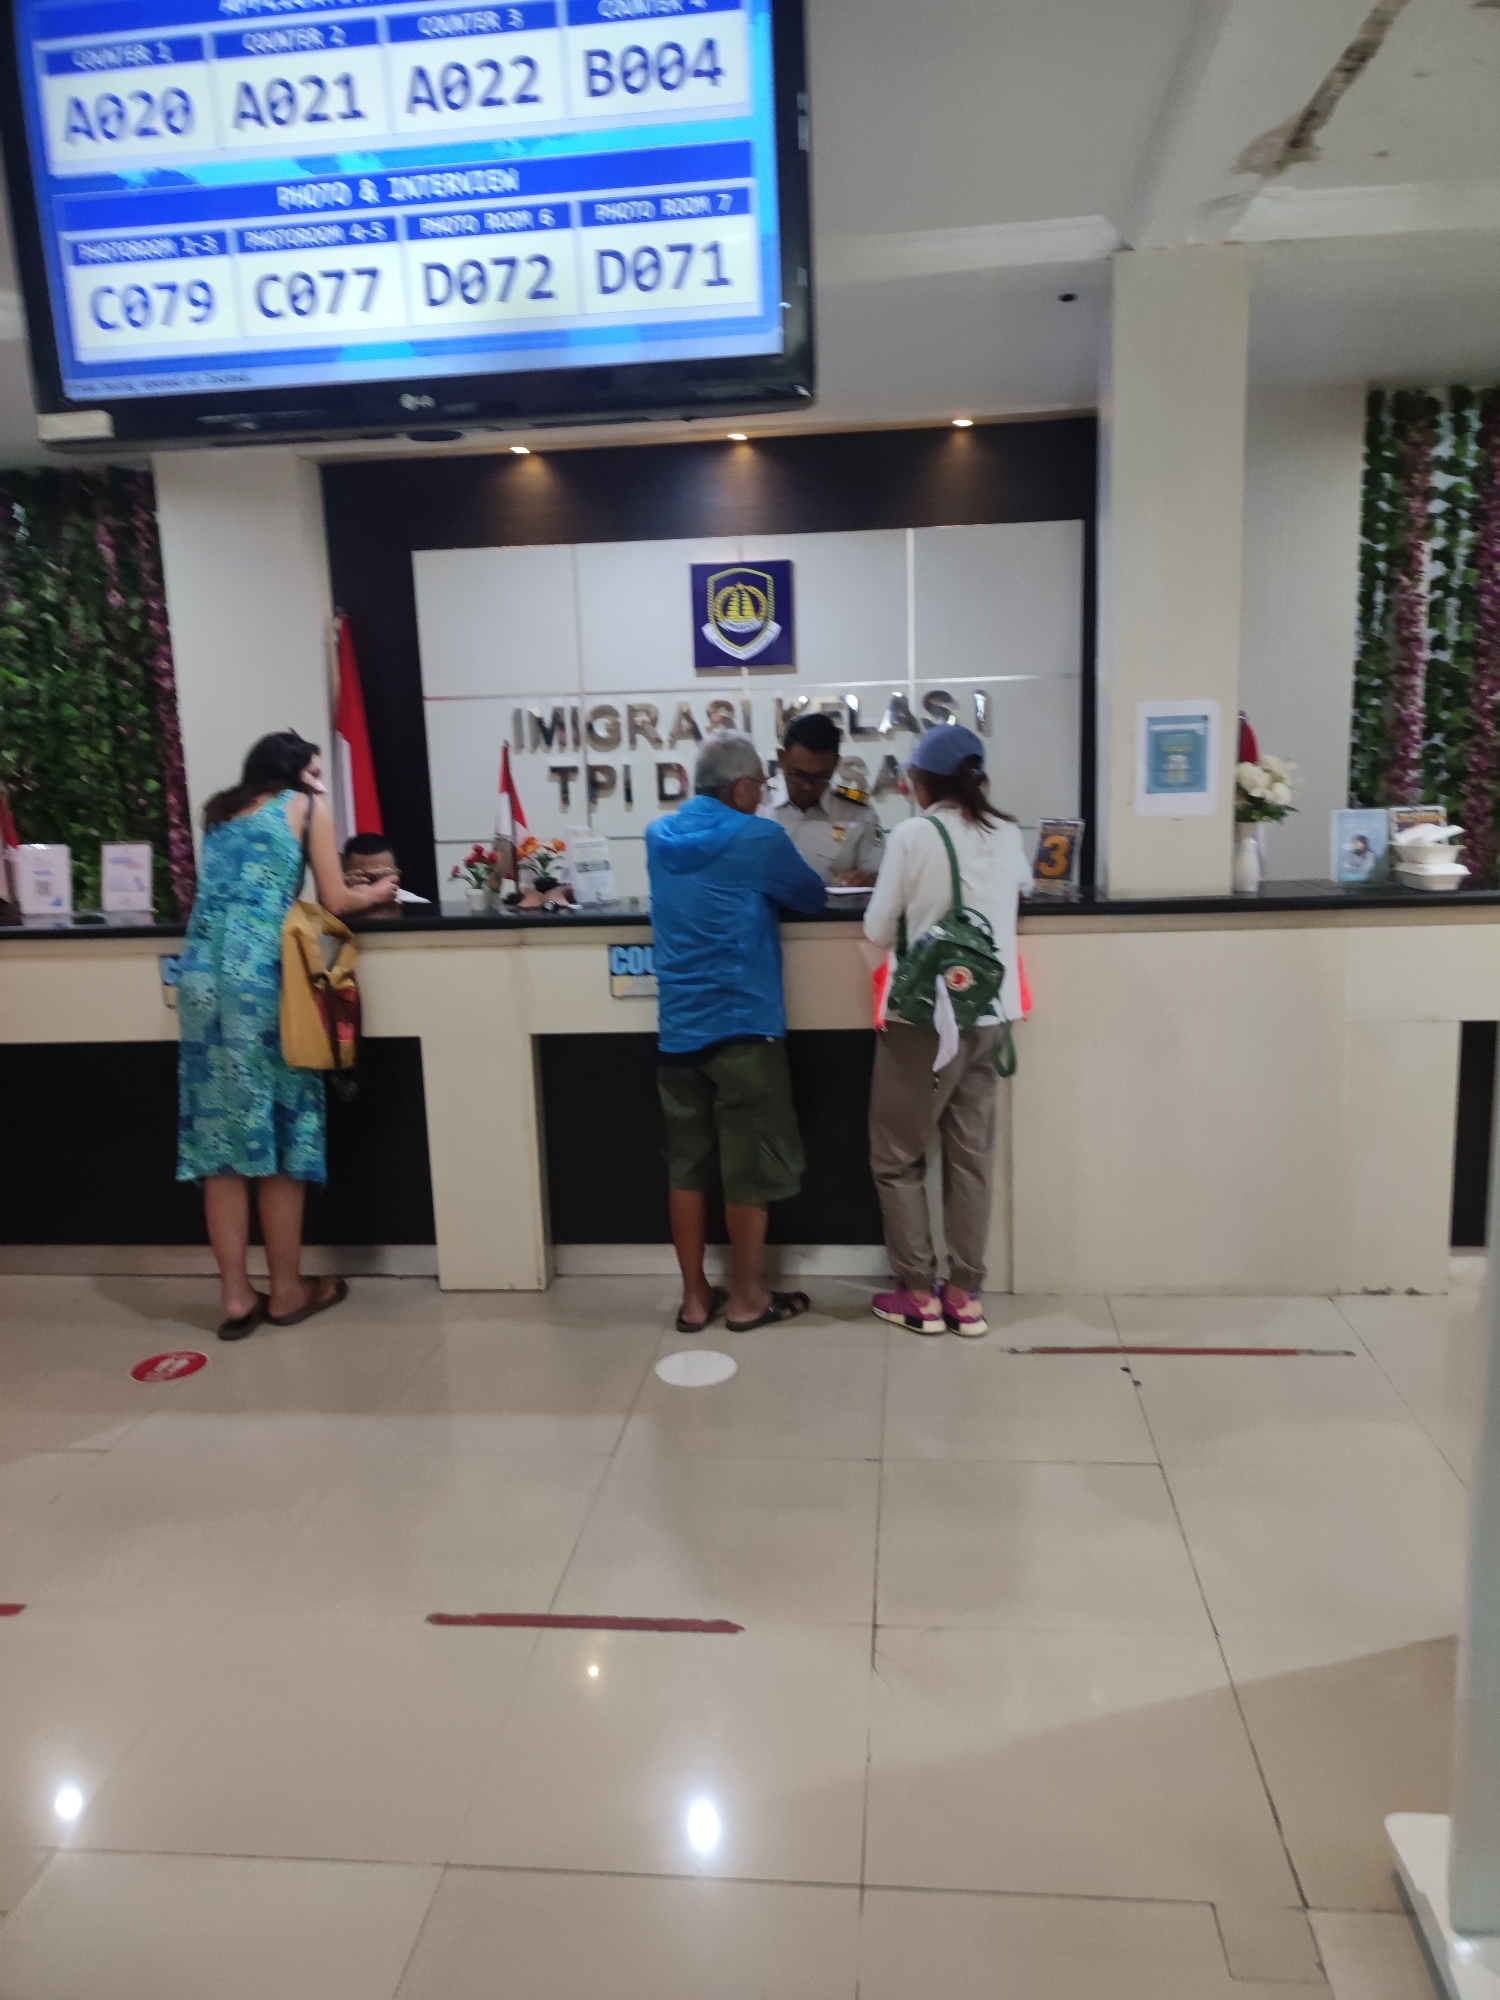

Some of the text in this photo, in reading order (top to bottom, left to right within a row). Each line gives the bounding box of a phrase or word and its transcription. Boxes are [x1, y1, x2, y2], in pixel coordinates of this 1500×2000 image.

[242, 25, 348, 55] COUNTER 2
[417, 8, 525, 38] COUNTER 3
[72, 41, 174, 71] COUNTER 1
[582, 37, 725, 98] B004
[231, 73, 367, 129] A021
[406, 55, 542, 114] A022
[64, 87, 197, 144] A020
[276, 167, 520, 210] PHOTO & INTERVIEW
[595, 193, 734, 224] PHOTO ROOM 7
[244, 221, 388, 251] PHOTOROOM 4-5
[420, 208, 556, 237] PHOTO ROOM 6
[254, 266, 384, 319] C077
[421, 254, 558, 307] D072
[596, 241, 733, 295] D071
[90, 277, 217, 330] C079
[511, 698, 753, 754] IMIGRASI
[973, 690, 993, 738] I
[548, 763, 635, 814] TPI
[1036, 834, 1070, 877] 3
